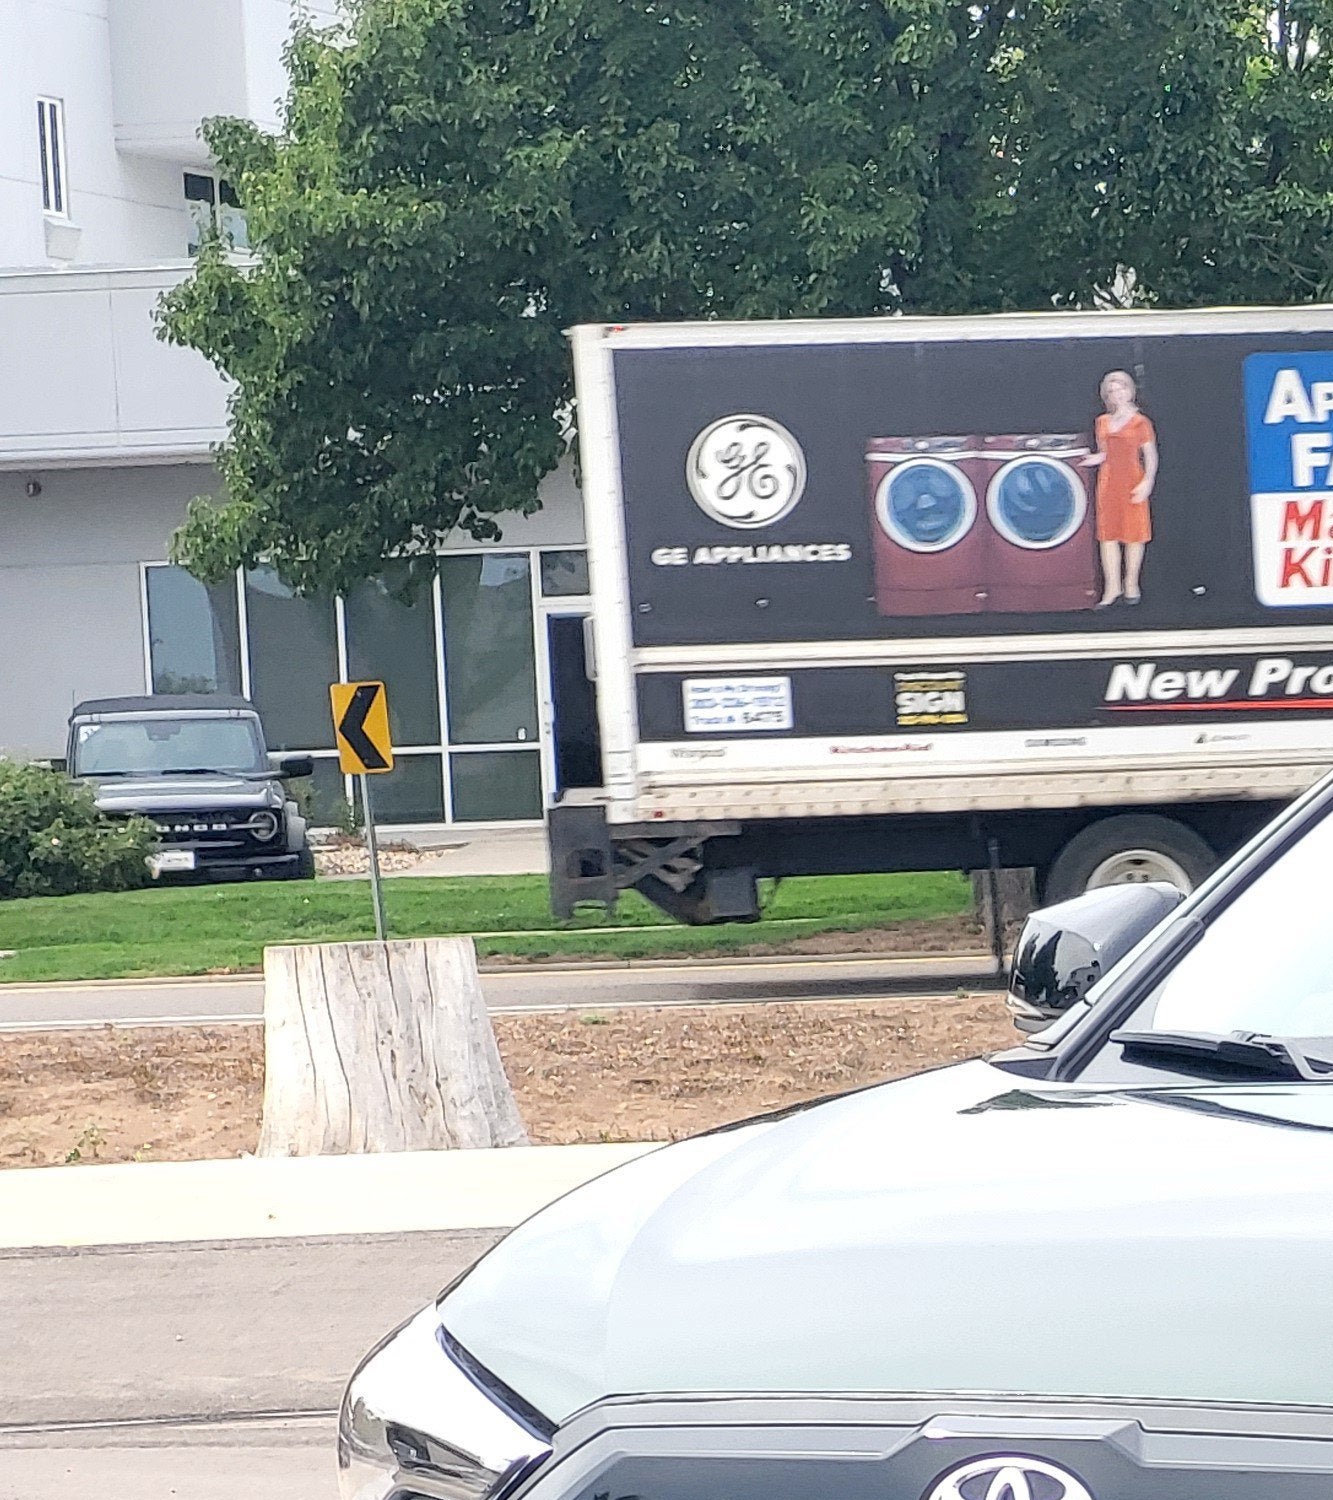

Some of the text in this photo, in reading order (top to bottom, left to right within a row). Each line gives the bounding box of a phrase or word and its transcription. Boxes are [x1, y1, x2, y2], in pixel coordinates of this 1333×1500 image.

[651, 543, 852, 566] GE APPLIANCES
[1104, 663, 1240, 701] New
